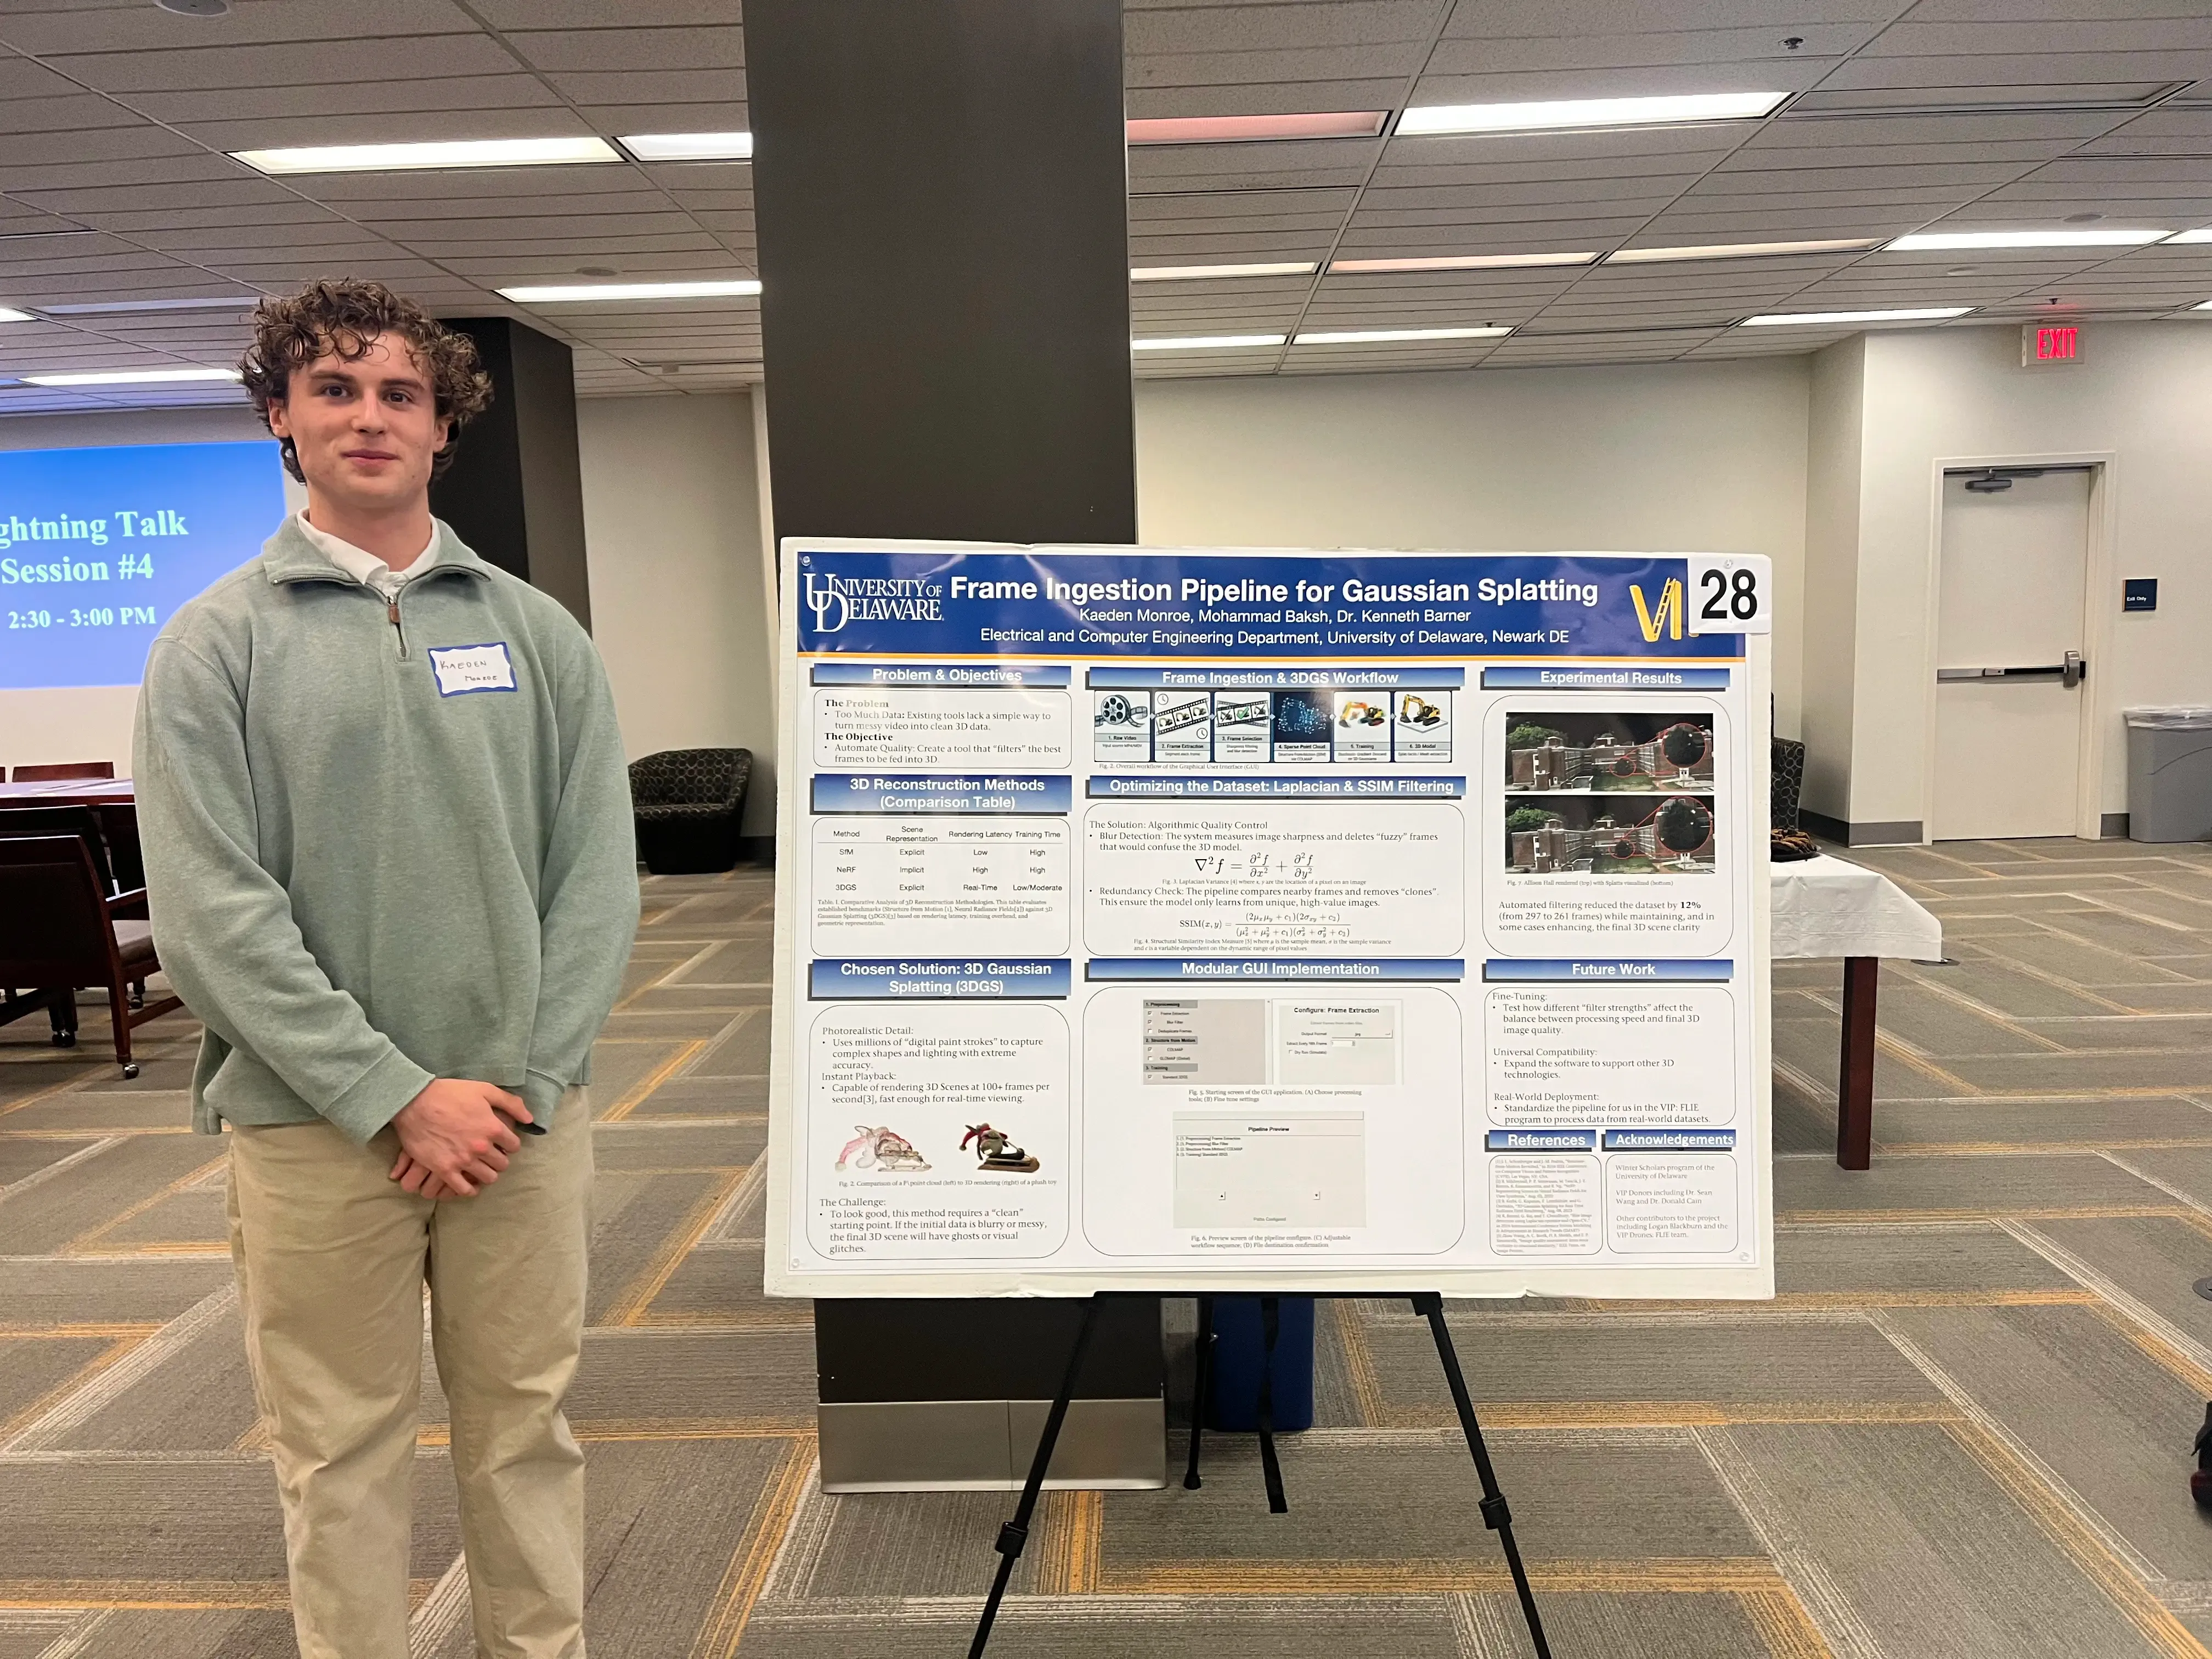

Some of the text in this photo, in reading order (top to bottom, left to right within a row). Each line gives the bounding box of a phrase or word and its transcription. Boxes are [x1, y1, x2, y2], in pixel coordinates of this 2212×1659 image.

[2038, 328, 2078, 359] EXIT
[115, 510, 189, 537] Talk
[1, 553, 154, 584] Session #4
[803, 573, 942, 611] UNIVERSITY OF
[951, 576, 1598, 607] Frame Ingestion Pipeline for Gaussian Splatting
[1701, 569, 1758, 620] 28
[8, 610, 51, 629] 2:30
[70, 607, 114, 627] 3:00
[119, 606, 156, 625] PM
[812, 591, 943, 632] DELAWARE
[1079, 608, 1471, 625] Kaeden Monroe, Mohammad Baksh, Dr. Kenneth Barner
[981, 628, 1570, 647] Electrical and Computer Engineering Department, University of Delaware, Newark DE
[439, 660, 487, 670] KAEDEN
[873, 668, 1022, 683] Problem & Objectives
[1163, 672, 1399, 686] Frame Ingestion & 3DGS Workflow
[1541, 671, 1682, 685] Experimental Results
[846, 699, 889, 708] Problem
[854, 710, 879, 719] Much
[907, 711, 942, 721] Existing
[992, 712, 1021, 722] simple
[1023, 714, 1040, 722] way
[845, 733, 893, 742] Objective
[850, 778, 1045, 791] 3D Reconstruction Methods
[1110, 780, 1454, 794] Optimizing the Dataset: Laplacian & SSIM Filtering
[881, 795, 1015, 810] (Comparison Table)
[1148, 821, 1199, 831] Algorithmic
[1201, 821, 1233, 831] Quality
[886, 835, 938, 843] Representation
[949, 831, 984, 839] Rendering
[1015, 831, 1042, 839] Training
[899, 884, 924, 892] Explicit
[1549, 901, 1583, 911] filtering
[1584, 901, 1617, 909] reduced
[1635, 901, 1665, 909] dataset
[1667, 901, 1678, 911] by
[840, 963, 1052, 975] Chosen Solution: 3D Gaussian
[1182, 962, 1379, 977] Modular GUI Implementation
[1573, 964, 1656, 975] Future Work
[889, 980, 1003, 995] Splatting (3DGS)
[1493, 992, 1547, 1002] Fine-Tuning:
[822, 1026, 913, 1035] Photorealistic Detail:
[1493, 1048, 1597, 1058] Universal Compatibility:
[822, 1072, 896, 1082] Instant Playback:
[1544, 1093, 1599, 1103] Deployment:
[1508, 1135, 1586, 1146] References
[1616, 1134, 1734, 1148] Acknowledgements
[820, 1198, 885, 1208] The Challenge:
